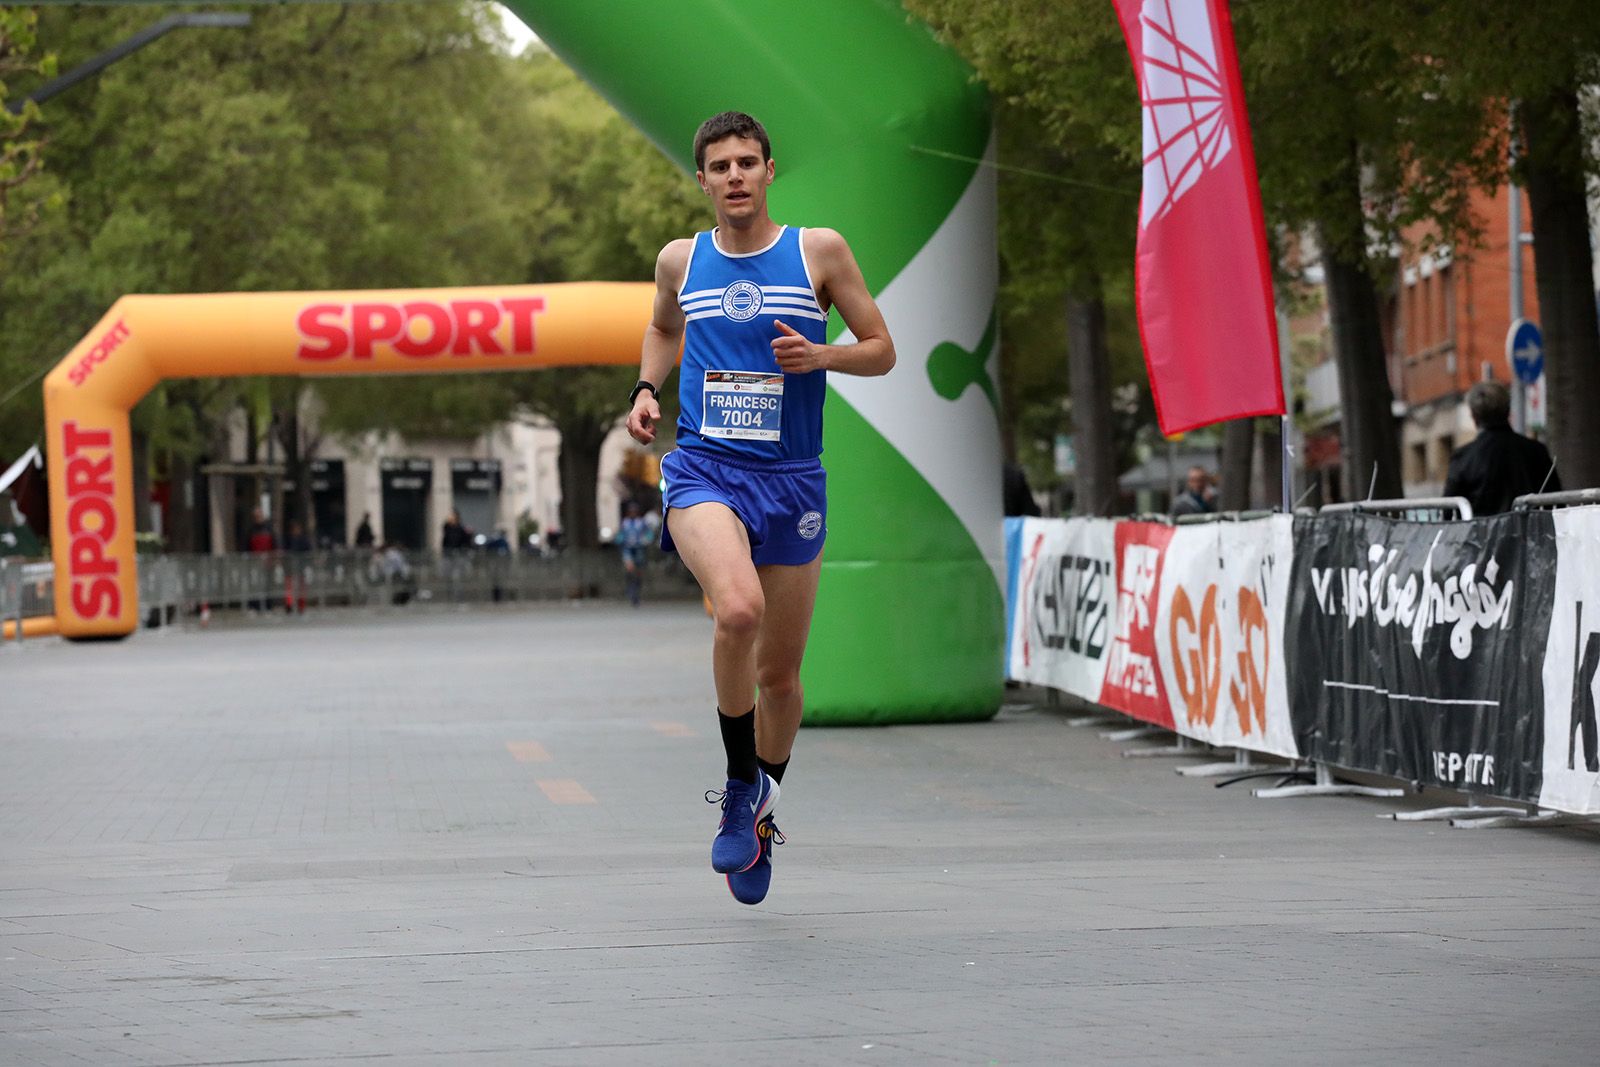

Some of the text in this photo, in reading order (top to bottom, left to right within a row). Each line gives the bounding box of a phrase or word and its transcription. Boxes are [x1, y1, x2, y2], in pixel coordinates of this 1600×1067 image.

[67, 318, 131, 387] SPORT
[297, 298, 545, 362] SPORT
[710, 395, 777, 410] FRANCESC
[721, 410, 762, 427] 7004
[62, 420, 121, 621] SPORT
